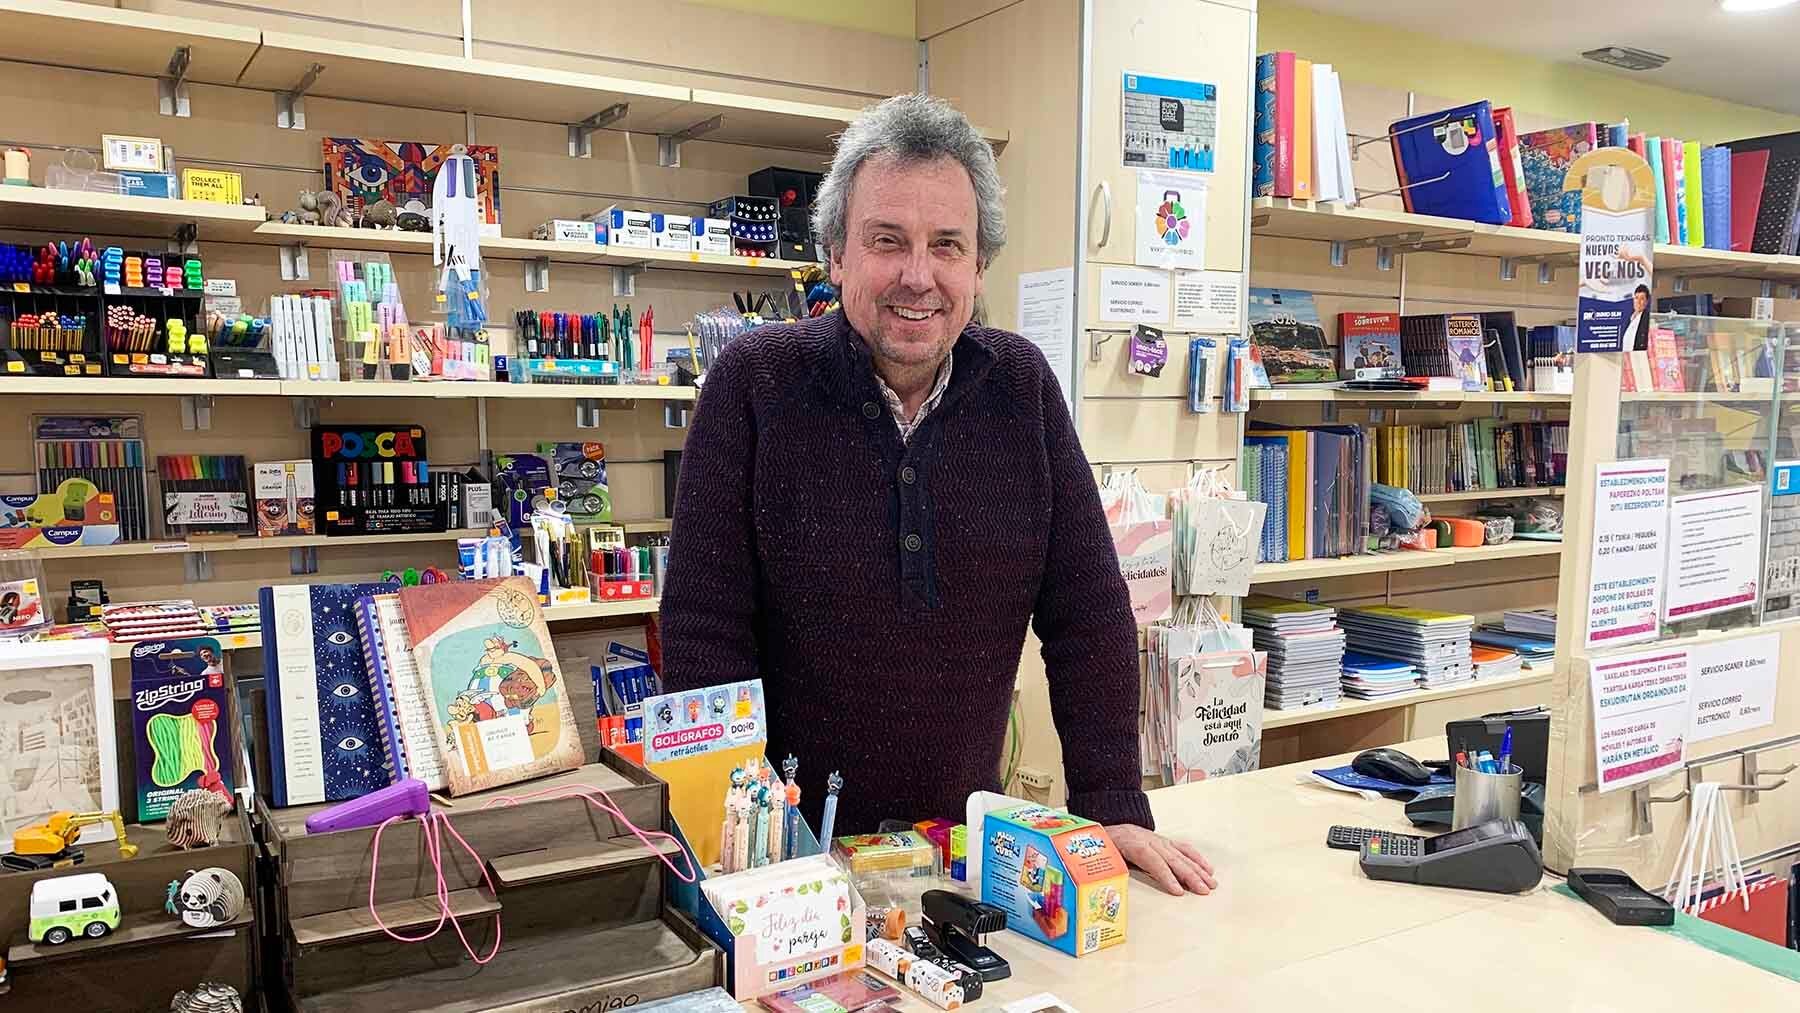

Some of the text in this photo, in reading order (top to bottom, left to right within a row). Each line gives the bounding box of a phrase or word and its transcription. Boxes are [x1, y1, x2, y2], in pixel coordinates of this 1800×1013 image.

[1585, 231, 1650, 243] PRONTO TENDRÁS
[1585, 243, 1620, 257] NUEVOS
[1585, 260, 1646, 280] VECNOS
[1447, 319, 1480, 328] MISTERIOS
[1448, 327, 1480, 336] ROMANOS
[321, 431, 417, 459] POSCA
[6, 495, 35, 504] Campus
[48, 528, 79, 539] Campus
[1592, 587, 1655, 604] DISPONE DE BOLSAS DE
[1593, 583, 1607, 592] ESTE
[1591, 599, 1654, 617] PAPEL PARA NUESTROS
[1591, 617, 1618, 629] CLIENTES
[134, 642, 166, 657] ZipString
[1700, 663, 1724, 676] SERVICIO
[1724, 660, 1744, 672] SCANER
[136, 678, 205, 705] ZipString
[1213, 696, 1224, 707] La
[1698, 693, 1743, 711] SERVICIO CORREO
[1194, 701, 1247, 722] Felicidad
[1203, 720, 1222, 731] está
[1600, 730, 1610, 740] LOS
[1627, 725, 1634, 735] DE
[1634, 722, 1650, 734] CARGA
[1649, 720, 1657, 730] DE
[653, 721, 756, 749] BOLÍGRAFOS DOHO
[1202, 729, 1240, 747] Dentro
[1602, 743, 1660, 766] HARÁN EN METÁLICO
[146, 788, 185, 798] ORIGINAL
[761, 907, 800, 938] Feliz
[788, 929, 829, 955] pareja
